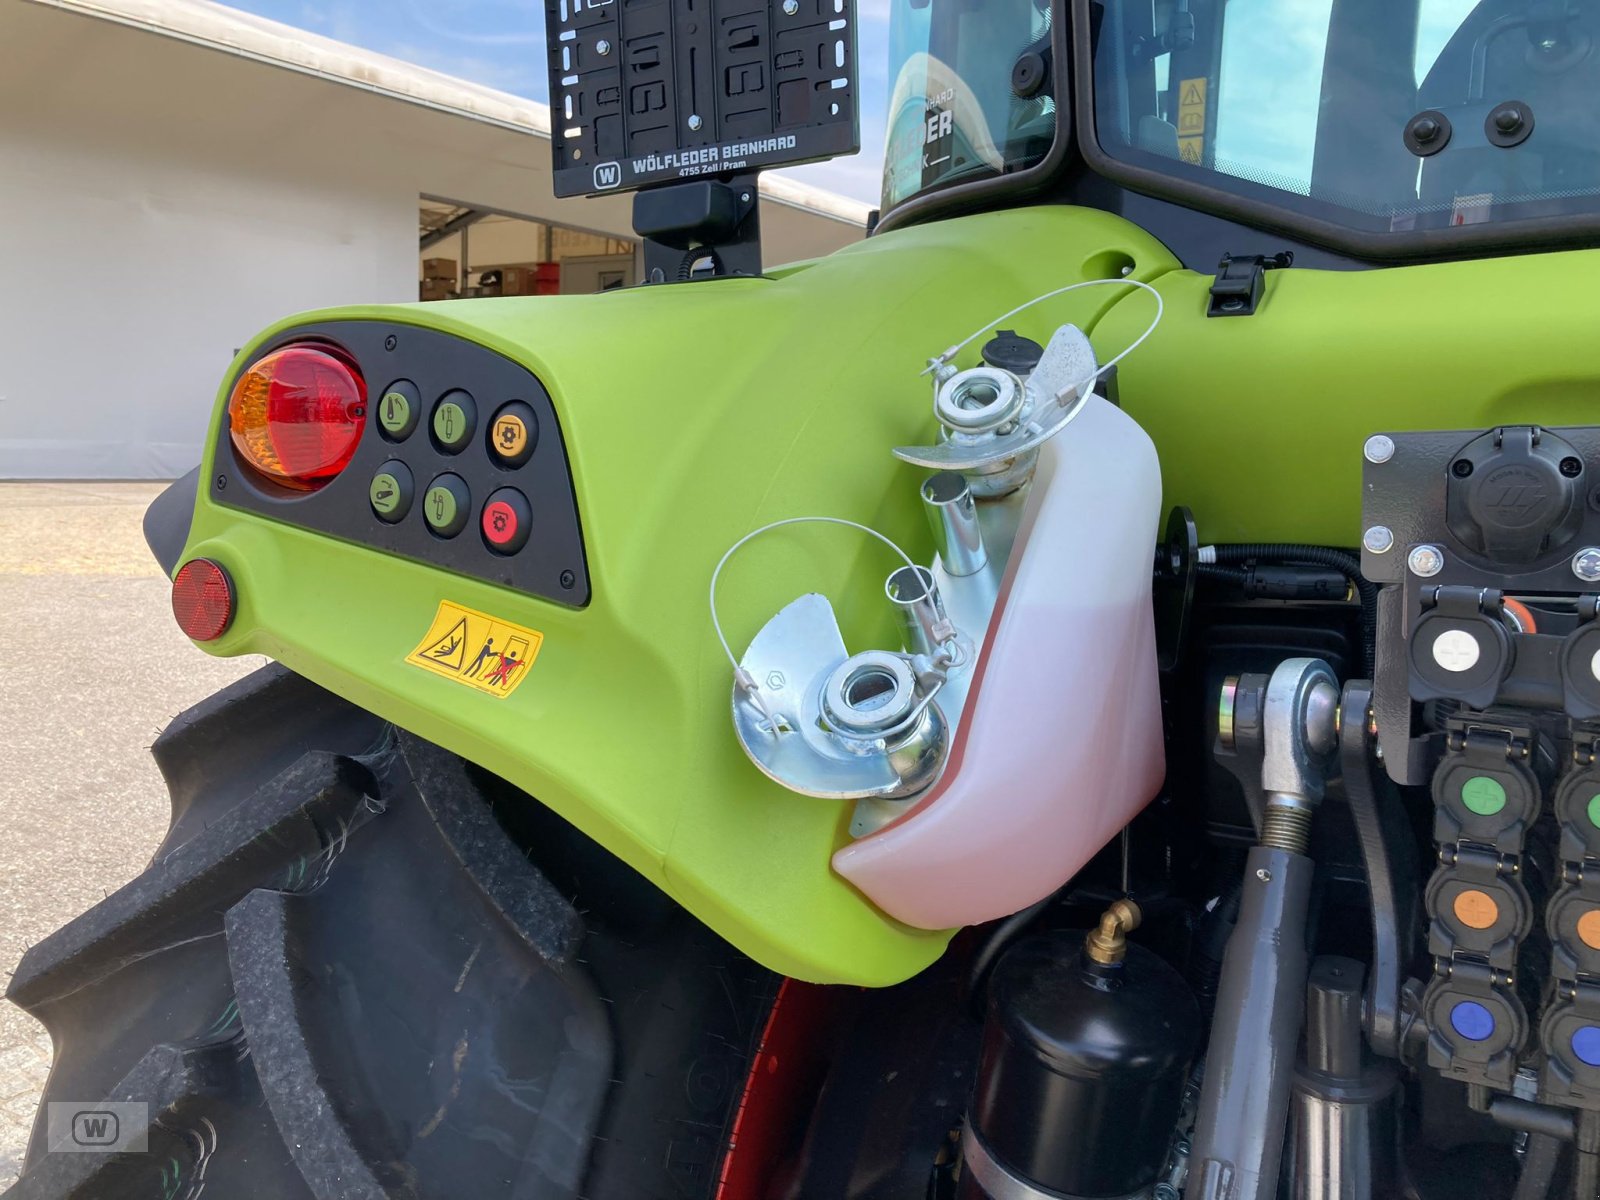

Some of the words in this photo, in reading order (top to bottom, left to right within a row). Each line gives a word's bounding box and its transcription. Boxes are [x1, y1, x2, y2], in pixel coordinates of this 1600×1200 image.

[632, 147, 718, 174] WÖLFLEDER
[722, 135, 796, 159] BERNHARD
[599, 167, 616, 184] W
[679, 166, 700, 177] 4755
